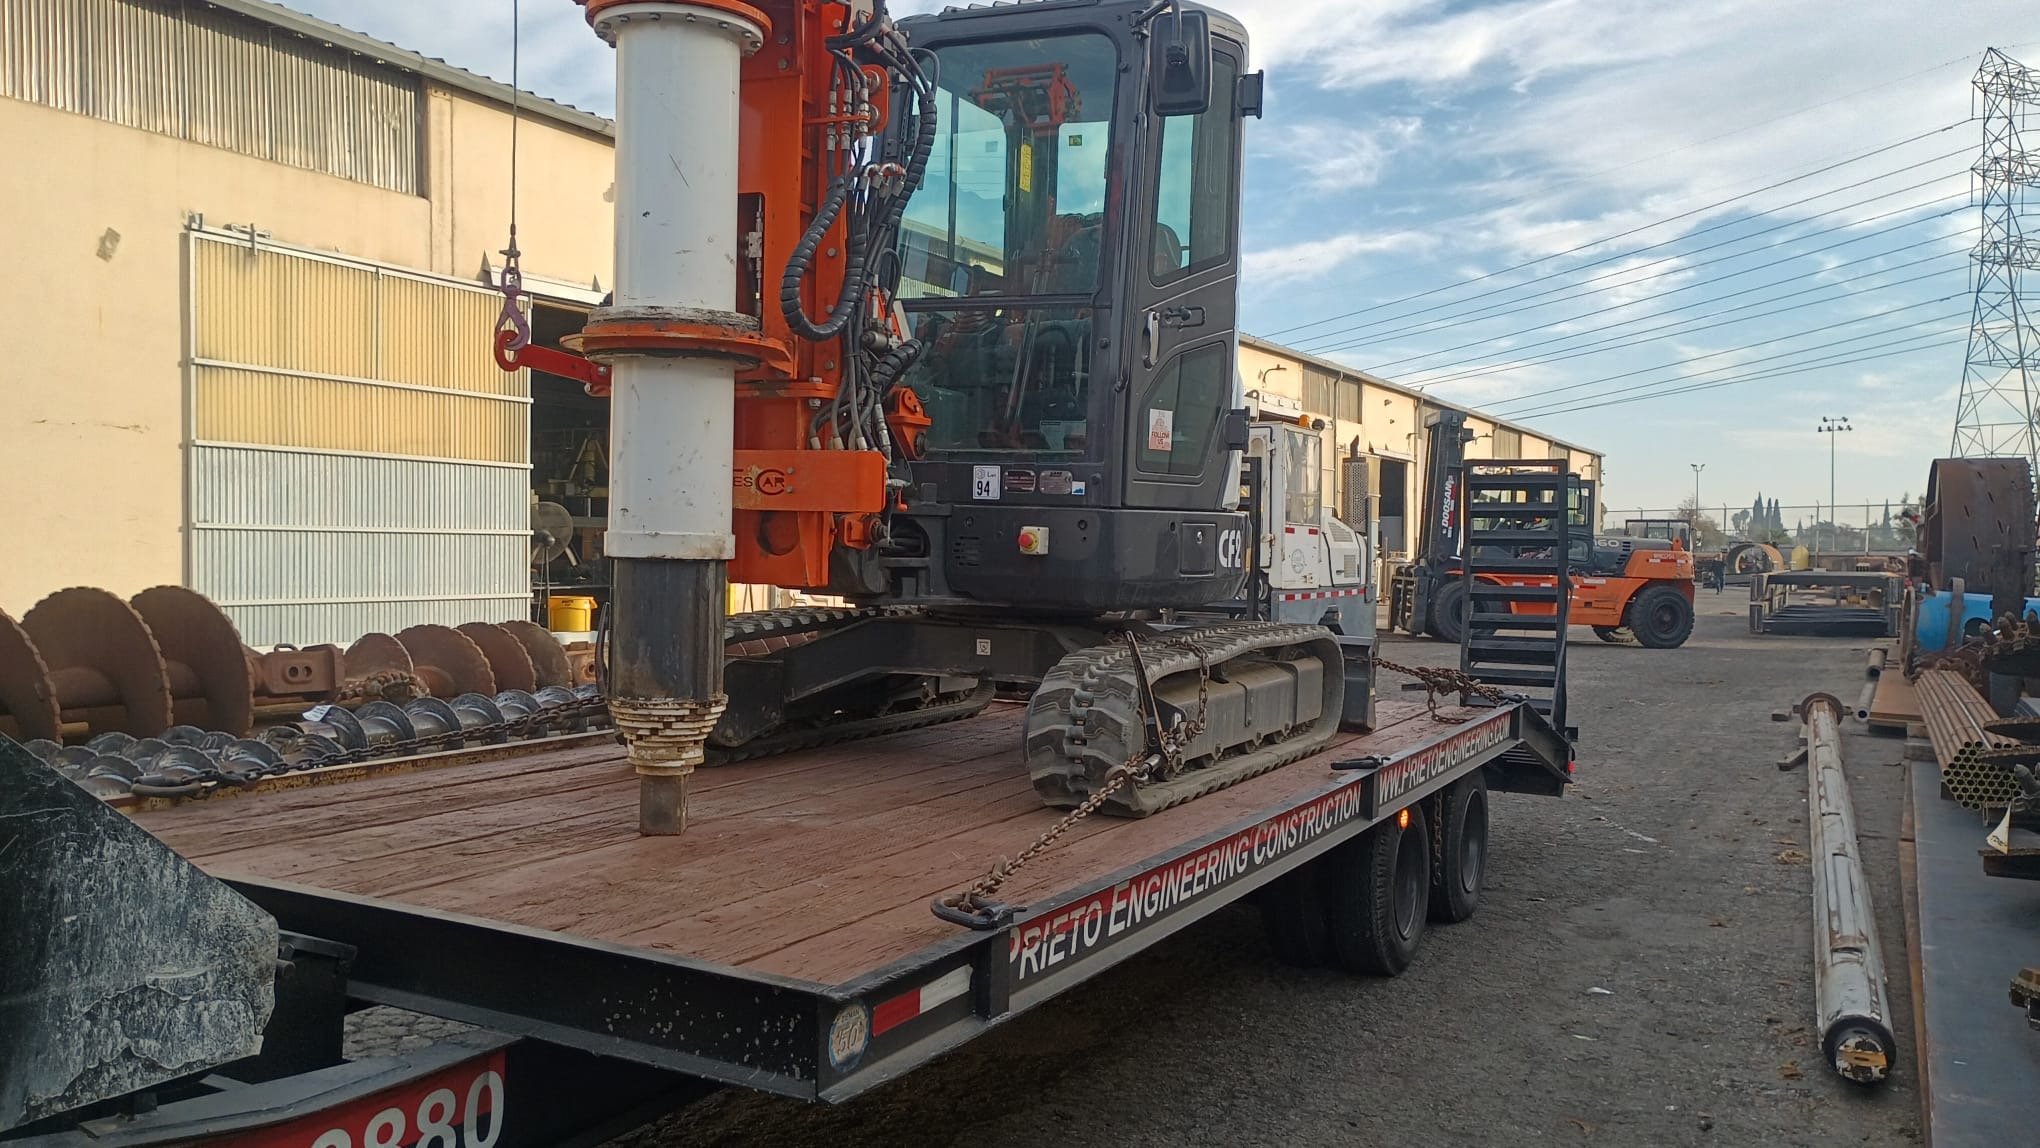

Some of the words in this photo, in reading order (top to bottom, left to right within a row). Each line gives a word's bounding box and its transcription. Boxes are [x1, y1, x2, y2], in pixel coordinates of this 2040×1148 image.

[976, 480, 990, 497] 94
[1442, 479, 1455, 528] DOOSAN
[1108, 835, 1249, 937] ENGINEERING
[1253, 783, 1362, 866] CONSTRUCTION
[311, 1070, 505, 1148] 880
